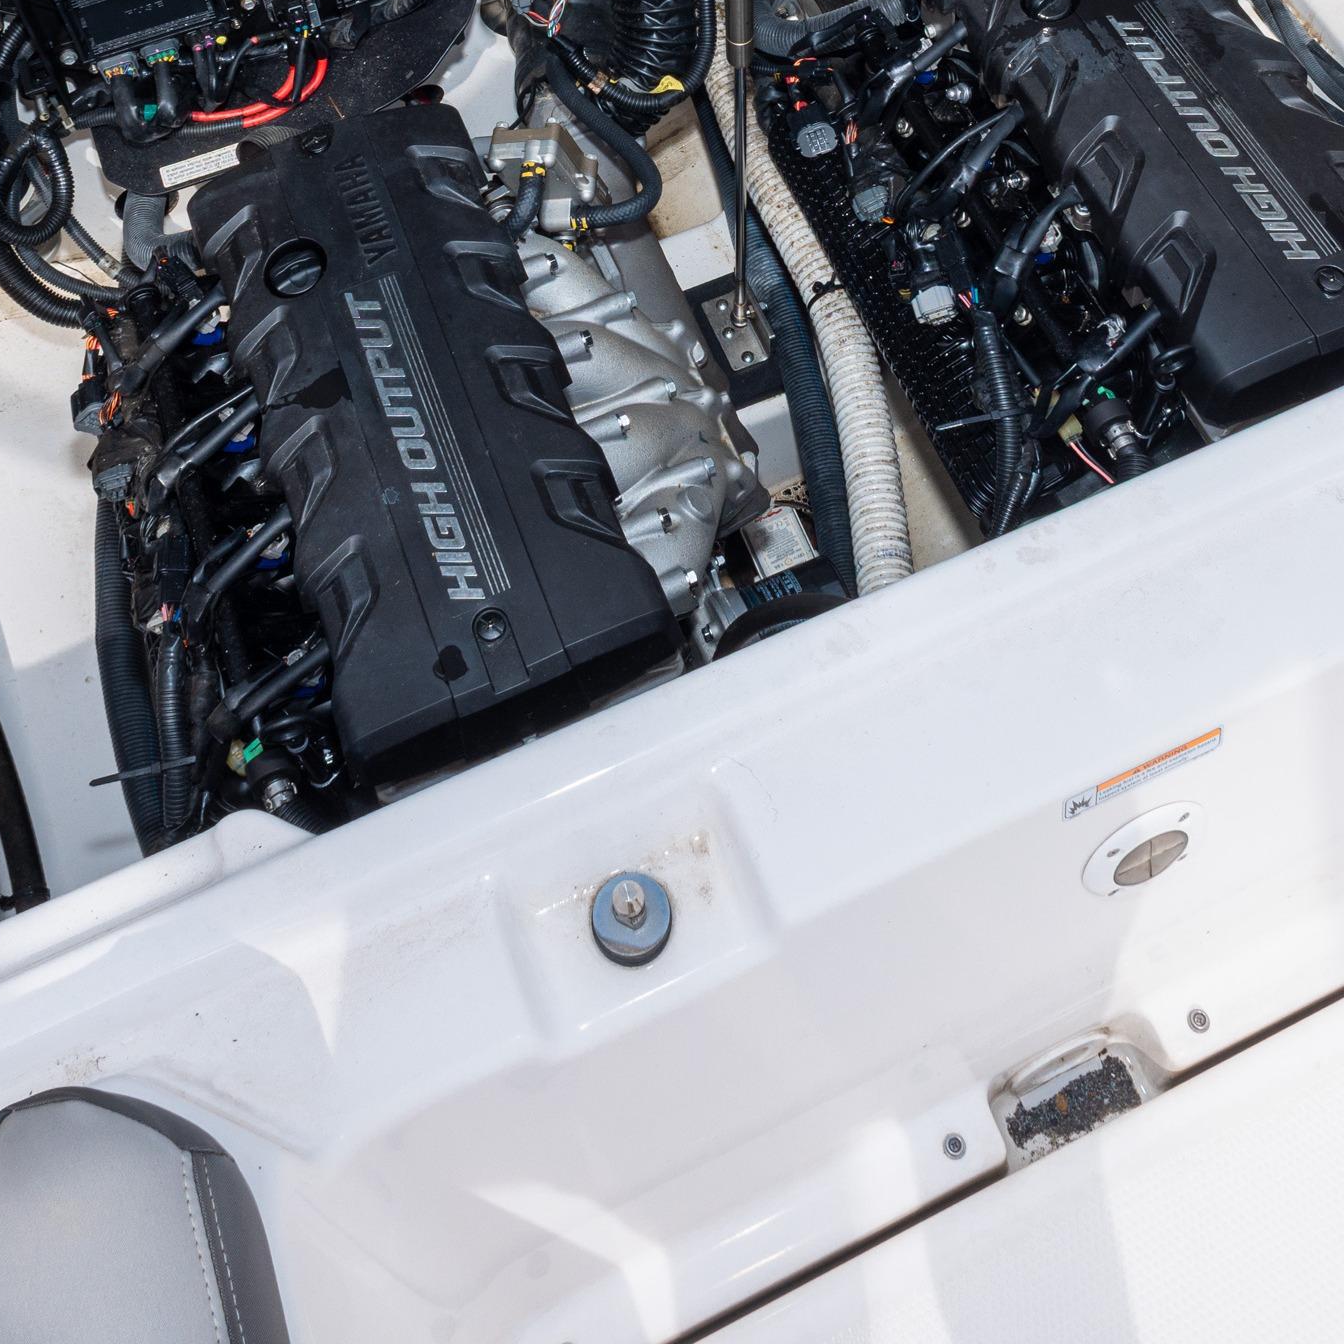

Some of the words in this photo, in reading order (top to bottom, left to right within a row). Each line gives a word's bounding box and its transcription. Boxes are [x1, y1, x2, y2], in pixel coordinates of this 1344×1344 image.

[1106, 15, 1240, 158] OUTPUT
[334, 154, 398, 267] YAMAHA
[1220, 167, 1321, 260] HIGH
[344, 292, 437, 469] OUTPUT
[411, 482, 485, 599] HIGH
[1143, 744, 1187, 769] WARNING
